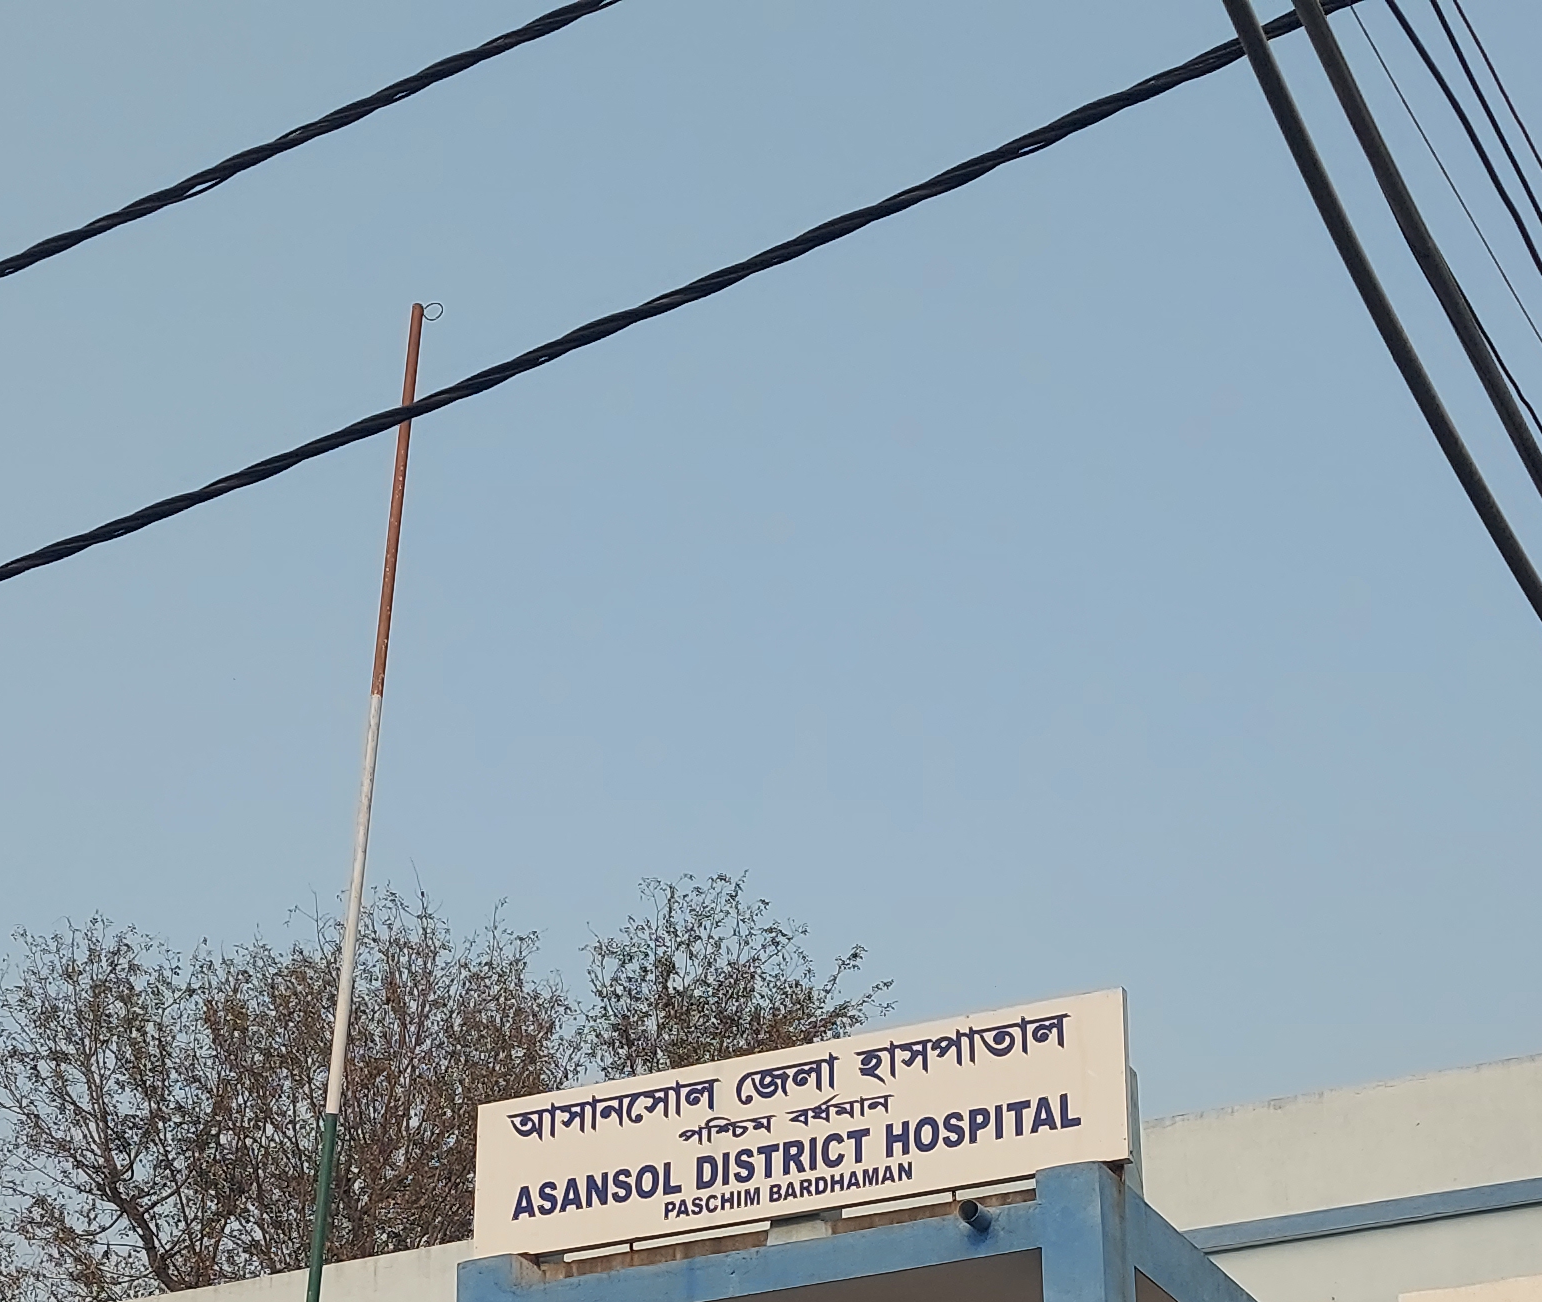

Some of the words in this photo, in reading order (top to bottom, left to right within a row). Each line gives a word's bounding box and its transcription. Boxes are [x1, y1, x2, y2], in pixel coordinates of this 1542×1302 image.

[506, 1078, 722, 1142] আসানসোল
[736, 1051, 840, 1106] জেলা
[854, 1012, 1071, 1086] হাসপাতাল
[678, 1114, 778, 1146] পশ্চিম
[784, 1093, 895, 1128] বর্ধমান
[511, 1161, 683, 1222] ASANSOL
[695, 1127, 871, 1191] DISTRICT
[885, 1092, 1083, 1158] HOSPITAL
[663, 1186, 761, 1220] PASCHIM
[768, 1161, 913, 1203] BARDHAMAN
